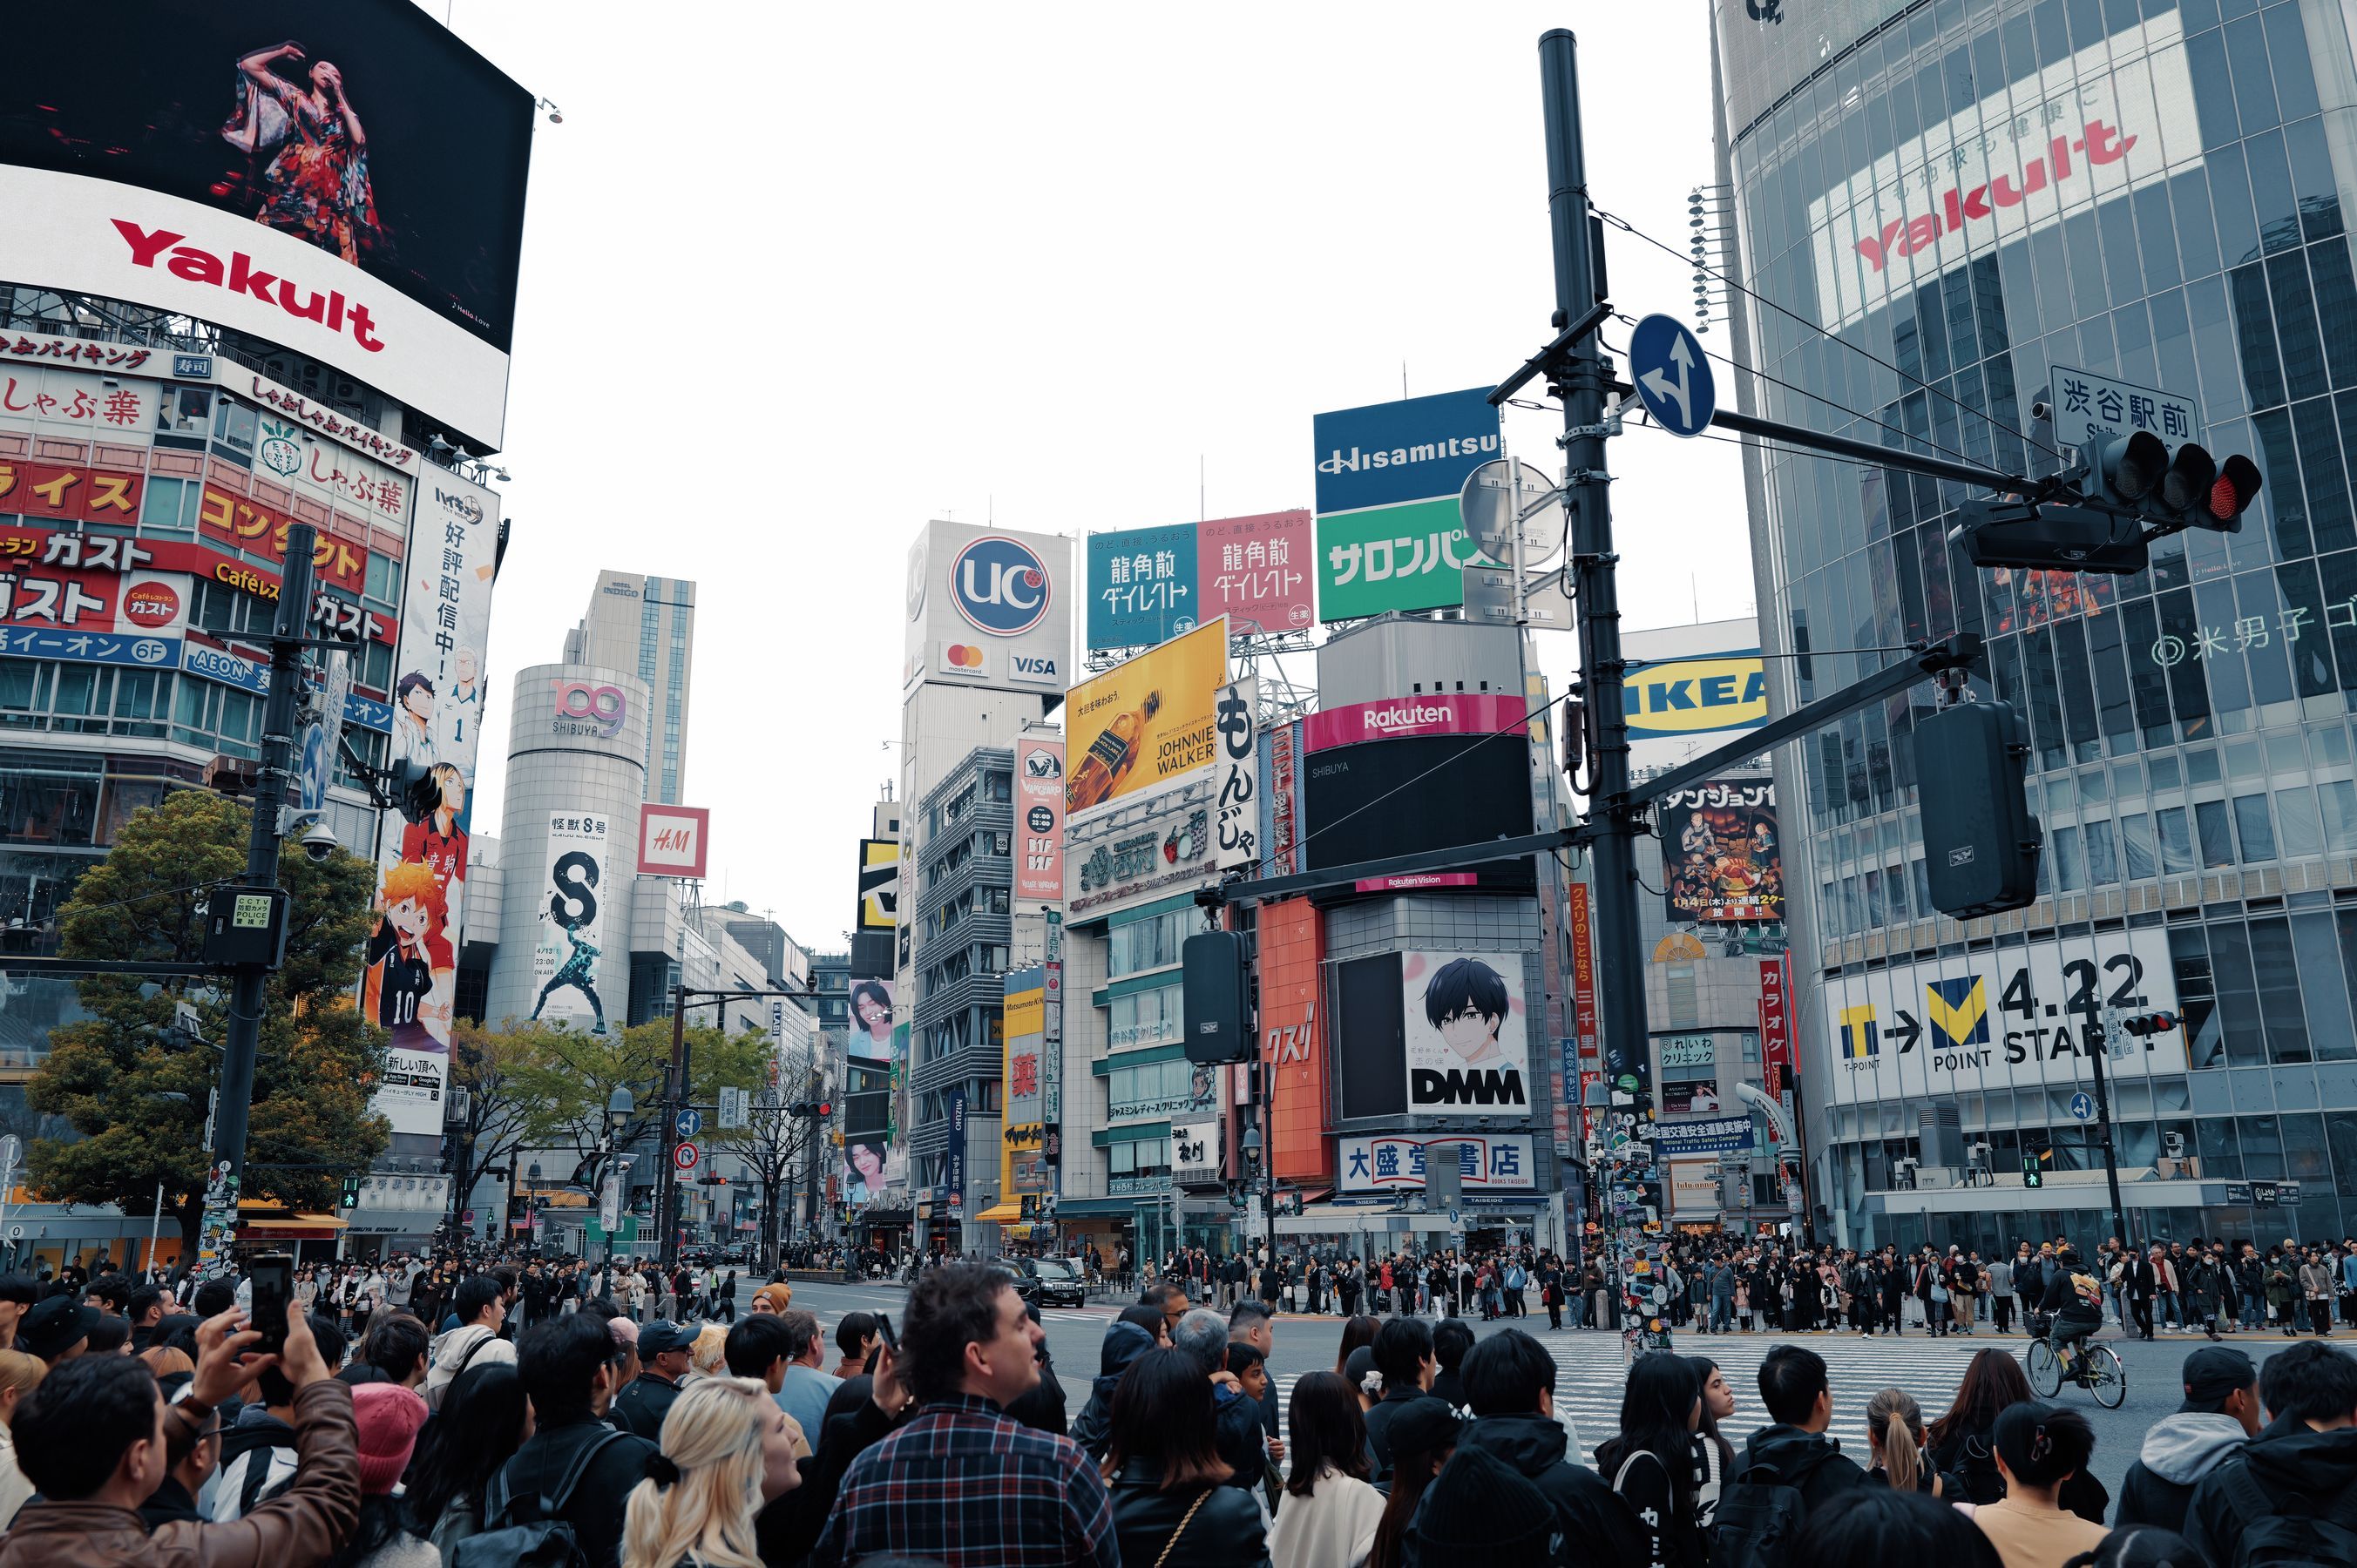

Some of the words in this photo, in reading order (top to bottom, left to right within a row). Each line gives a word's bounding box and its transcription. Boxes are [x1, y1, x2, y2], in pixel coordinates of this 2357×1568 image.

[1851, 119, 2137, 273] Yakult
[110, 218, 384, 353] Yakult
[457, 304, 474, 320] Hello
[476, 314, 491, 328] Love
[177, 359, 209, 375] 寿司
[3, 377, 141, 425] しゃぶ葉
[2064, 378, 2188, 439] 渋谷駅前
[254, 376, 413, 465] しゃぶしゃぶバイキング
[1317, 434, 1497, 474] Hisamitsu
[310, 448, 403, 514] しゃぶ葉
[443, 505, 454, 515] FLY
[44, 532, 152, 571] ガスト
[1223, 537, 1290, 572] 龍角散
[1110, 550, 1175, 585] 龍角散
[603, 586, 640, 598] INDIGO
[1101, 582, 1189, 615] ダイレクト
[1214, 569, 1304, 603] ダイレクト
[131, 601, 173, 615] ガスト
[434, 521, 465, 680] 好評配信中！
[1225, 604, 1259, 614] スティック
[314, 594, 384, 640] ガスト
[1111, 616, 1145, 627] スティック
[1290, 610, 1310, 621] 生薬
[135, 645, 163, 659] 6F
[195, 651, 246, 680] AEON
[948, 666, 983, 675] mastercard
[1012, 656, 1057, 676] VISA
[1097, 667, 1124, 685] WALKER
[1623, 672, 1766, 715] IKEA
[550, 679, 627, 738] 109
[1364, 704, 1452, 729] Rakuten
[454, 718, 463, 742] 1
[552, 722, 599, 736] SHIBUYA
[1157, 725, 1214, 760] JOHNNIE
[1157, 743, 1214, 775] WALKER
[1312, 761, 1349, 778] SHIBUYA
[1217, 686, 1255, 858] もんじゃ
[552, 817, 606, 834] 怪獣8号
[654, 828, 691, 854] H&M
[1028, 837, 1052, 853] B1F
[426, 852, 457, 873] 音駒
[1027, 855, 1054, 870] B2F
[1388, 877, 1417, 886] Rakuten
[1418, 875, 1441, 885] Vision
[235, 918, 267, 927] 警視庁
[1572, 888, 1588, 982] クスリのことなら
[1998, 953, 2149, 1021] 4.22
[393, 990, 415, 1024] 10
[1006, 999, 1033, 1011] Matsumoto
[1762, 971, 1783, 1051] カラオケ
[772, 1012, 781, 1036] LABI
[1577, 990, 1595, 1051] 三千里
[1675, 1037, 1712, 1050] れいわ
[389, 1055, 442, 1075] 新しい頂へ。
[1663, 1051, 1713, 1064] クリニック
[1844, 1058, 1880, 1073] T-POINT
[1934, 1050, 1992, 1073] POINT
[1012, 1052, 1038, 1098] 薬
[1564, 1042, 1577, 1102] 大盛堂商事ビル
[1411, 1068, 1527, 1105] DMM
[725, 1090, 735, 1125] 渋谷駅前
[954, 1098, 963, 1131] MIZUHO
[1109, 1099, 1189, 1117] ジャスミンレディースクリニック
[1655, 1119, 1752, 1139] 全国交通安全運動実施中
[1178, 1140, 1204, 1163] 松川
[1349, 1144, 1520, 1179] 大盛堂書店
[1110, 1182, 1134, 1193] 渋谷西村
